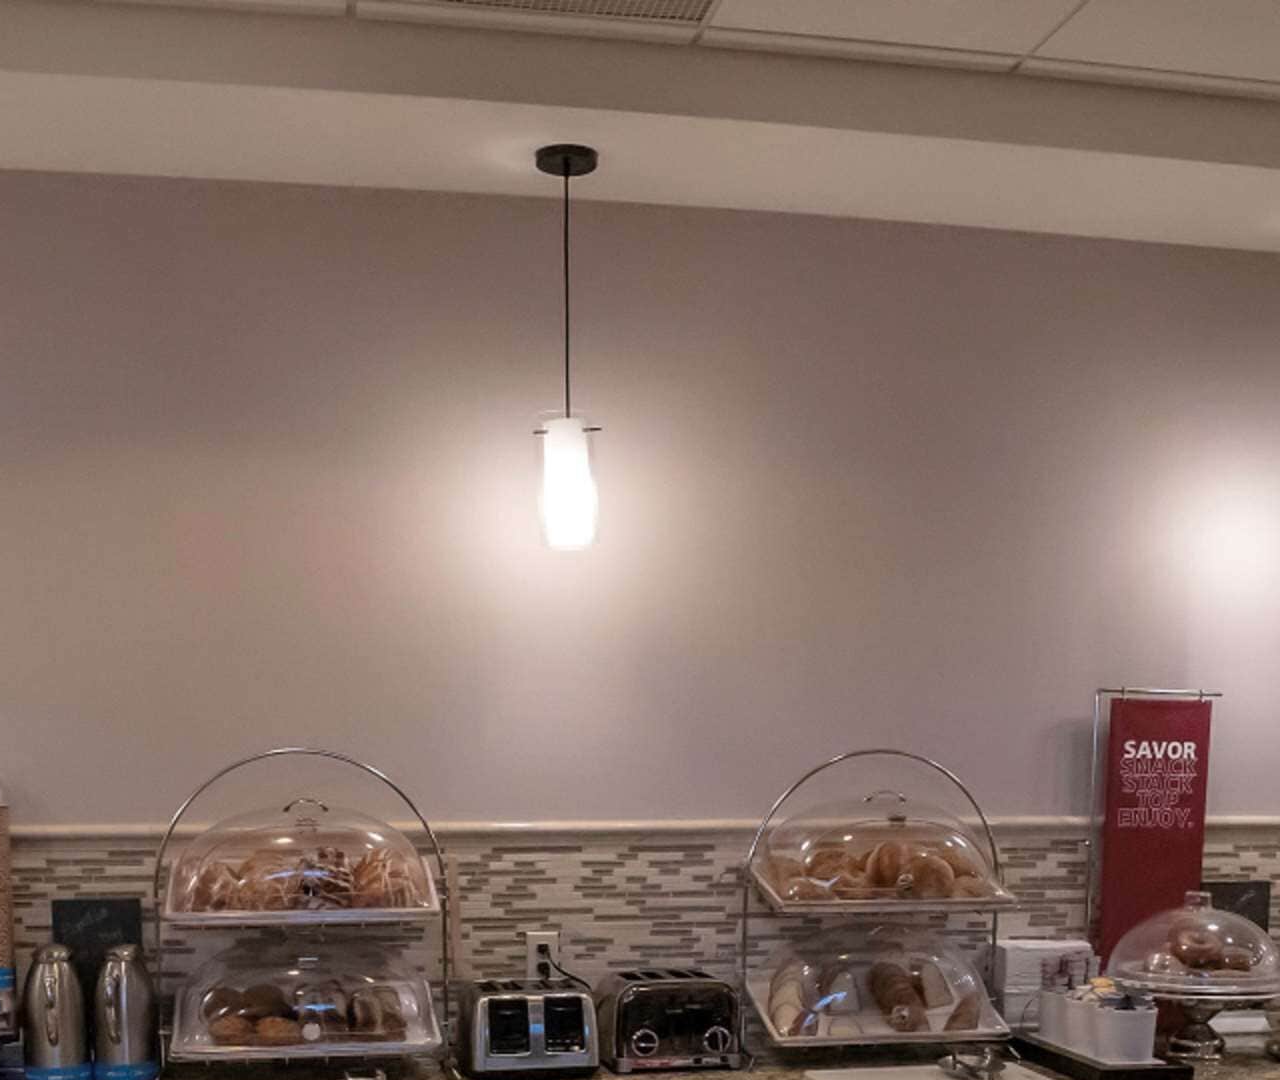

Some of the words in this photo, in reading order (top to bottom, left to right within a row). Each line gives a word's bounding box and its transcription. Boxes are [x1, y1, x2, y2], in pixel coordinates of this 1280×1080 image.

[1123, 740, 1197, 759] SAVOR
[1121, 773, 1194, 794] STACK
[1136, 789, 1180, 809] TOP
[1118, 807, 1194, 828] ENJOY.
